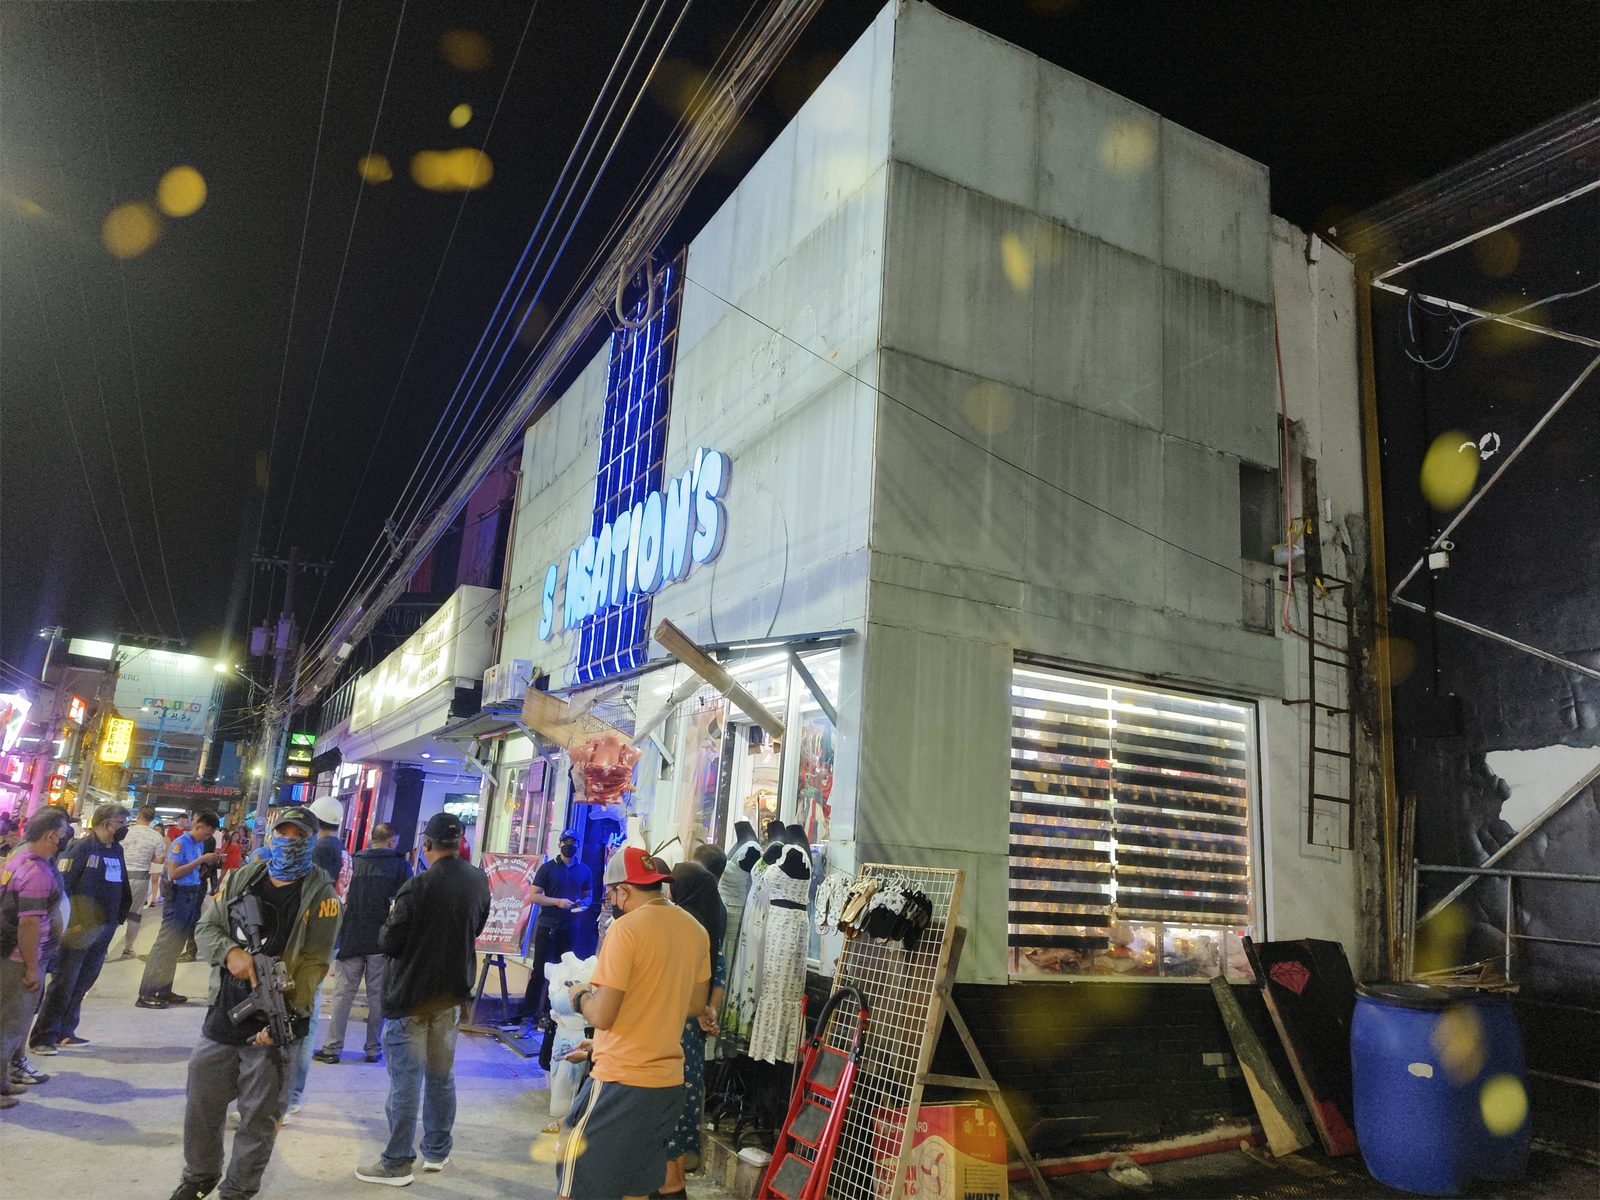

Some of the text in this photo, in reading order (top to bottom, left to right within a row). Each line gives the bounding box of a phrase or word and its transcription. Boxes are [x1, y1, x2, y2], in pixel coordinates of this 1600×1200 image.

[538, 446, 731, 641] SNSATION'S
[105, 719, 119, 754] OPERA
[510, 858, 528, 869] JOIN
[318, 897, 340, 918] NBI
